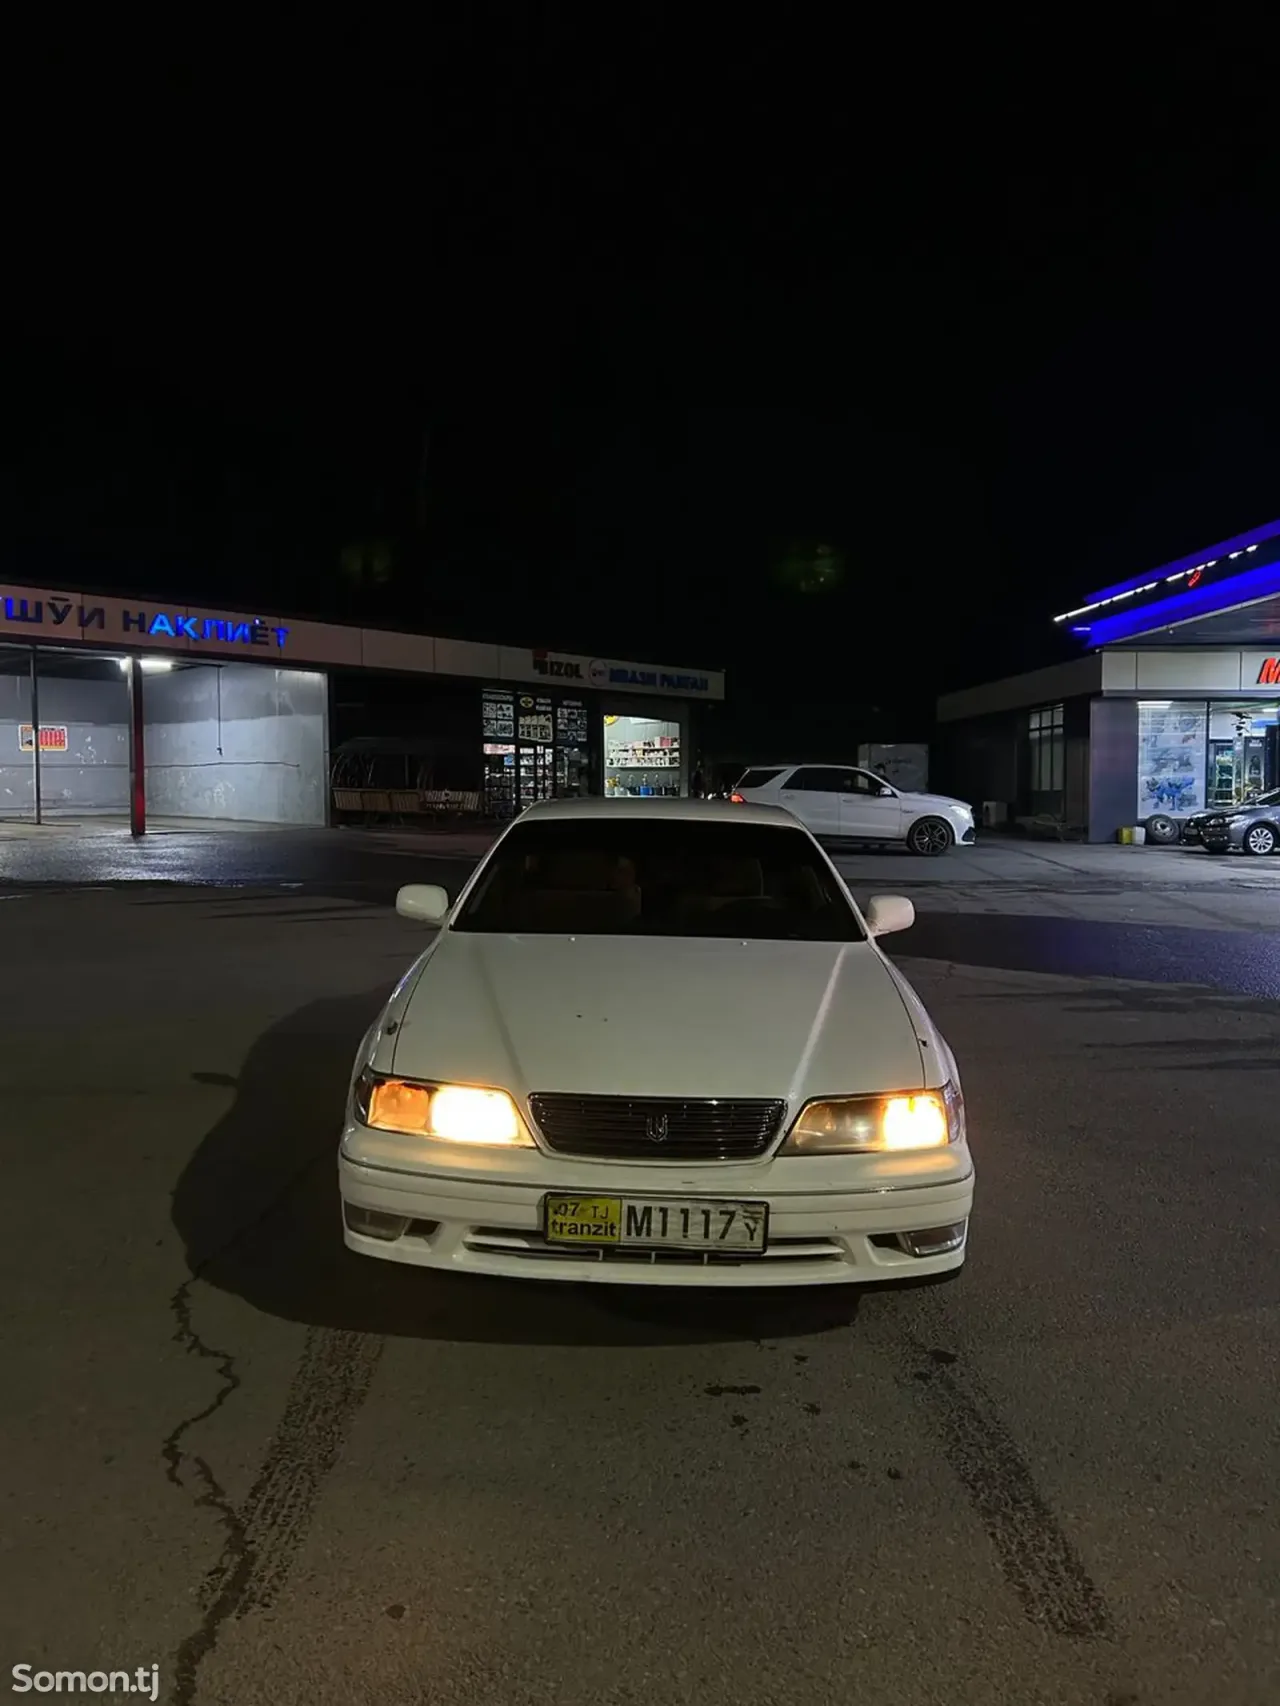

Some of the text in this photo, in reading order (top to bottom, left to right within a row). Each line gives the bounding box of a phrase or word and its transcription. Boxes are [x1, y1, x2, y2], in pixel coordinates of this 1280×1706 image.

[0, 596, 105, 629] ШӮИ
[592, 1205, 609, 1219] TJ
[552, 1219, 616, 1237] tranzit
